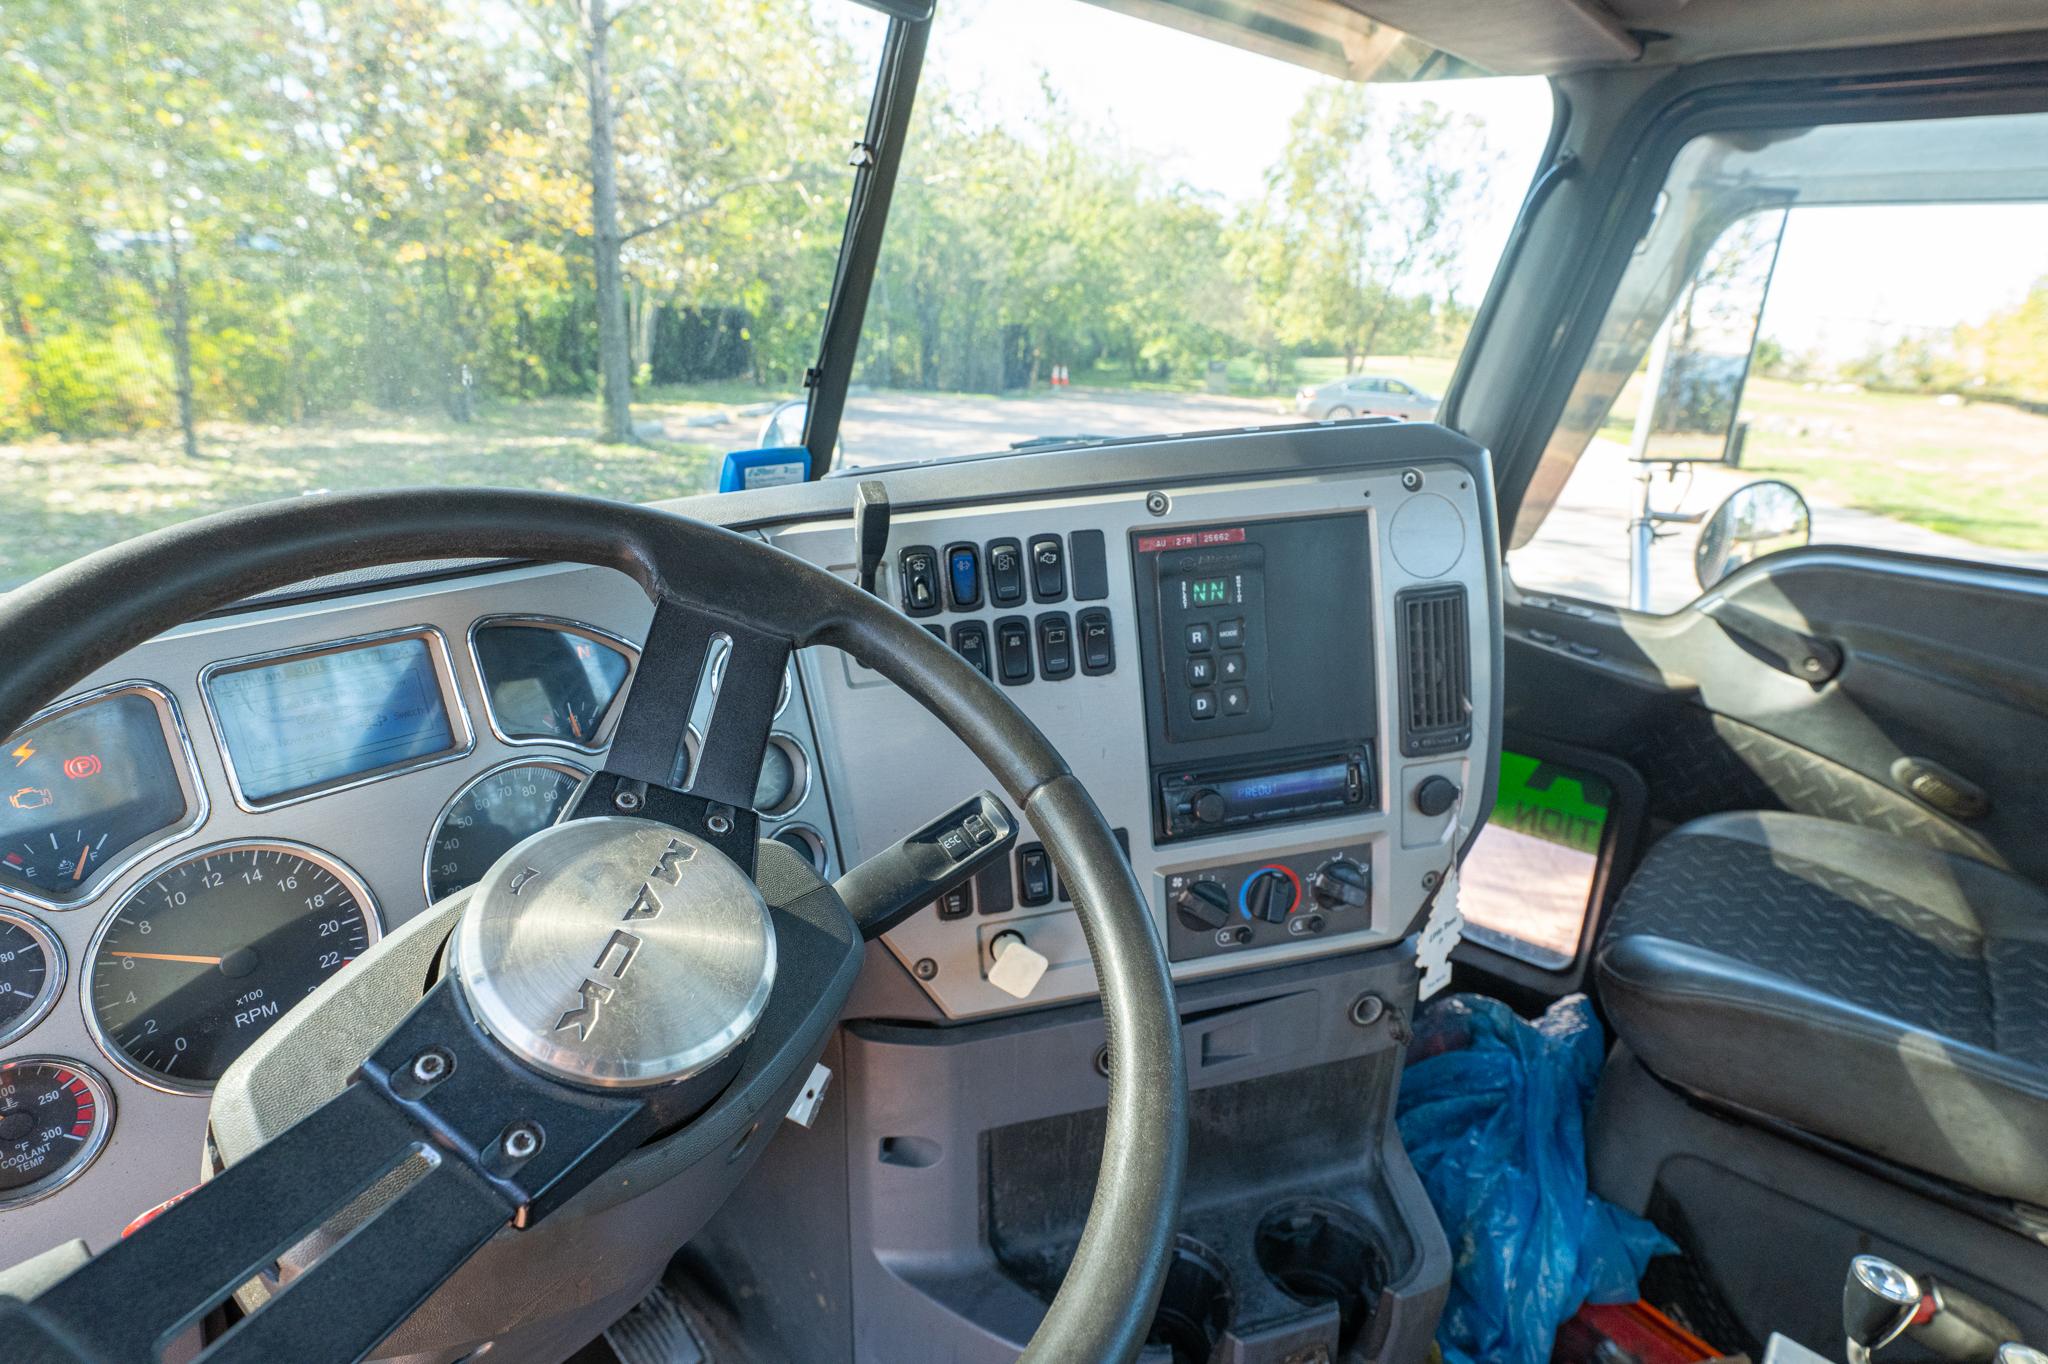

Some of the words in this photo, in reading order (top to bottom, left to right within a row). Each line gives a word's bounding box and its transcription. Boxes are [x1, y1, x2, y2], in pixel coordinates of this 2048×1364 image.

[1191, 631, 1202, 644] R
[1194, 665, 1205, 677] N
[1196, 699, 1207, 711] D
[498, 786, 512, 797] 70
[522, 784, 537, 797] 80
[543, 789, 558, 803] 90
[474, 798, 491, 811] 60
[457, 815, 473, 829] 50
[443, 838, 459, 850] 40
[944, 834, 962, 849] ESC
[89, 851, 99, 861] F
[26, 866, 37, 878] E
[242, 868, 263, 884] 14
[441, 862, 458, 876] 30
[201, 872, 224, 889] 12
[277, 876, 298, 892] 16
[164, 891, 187, 908] 10
[304, 894, 325, 910] 18
[139, 920, 152, 935] 8
[318, 919, 339, 936] 20
[555, 837, 698, 1042] MACK
[122, 956, 135, 970] 6
[319, 951, 340, 969] 22
[125, 991, 138, 1005] 4
[236, 988, 264, 1007] x100
[234, 1001, 280, 1029] RPM
[144, 1019, 159, 1034] 2
[175, 1037, 187, 1051] 0
[0, 1085, 16, 1098] 00
[37, 1090, 60, 1106] 250
[41, 1126, 62, 1142] 300
[1, 1142, 51, 1170] COOLANT
[16, 1156, 46, 1174] TEMP
